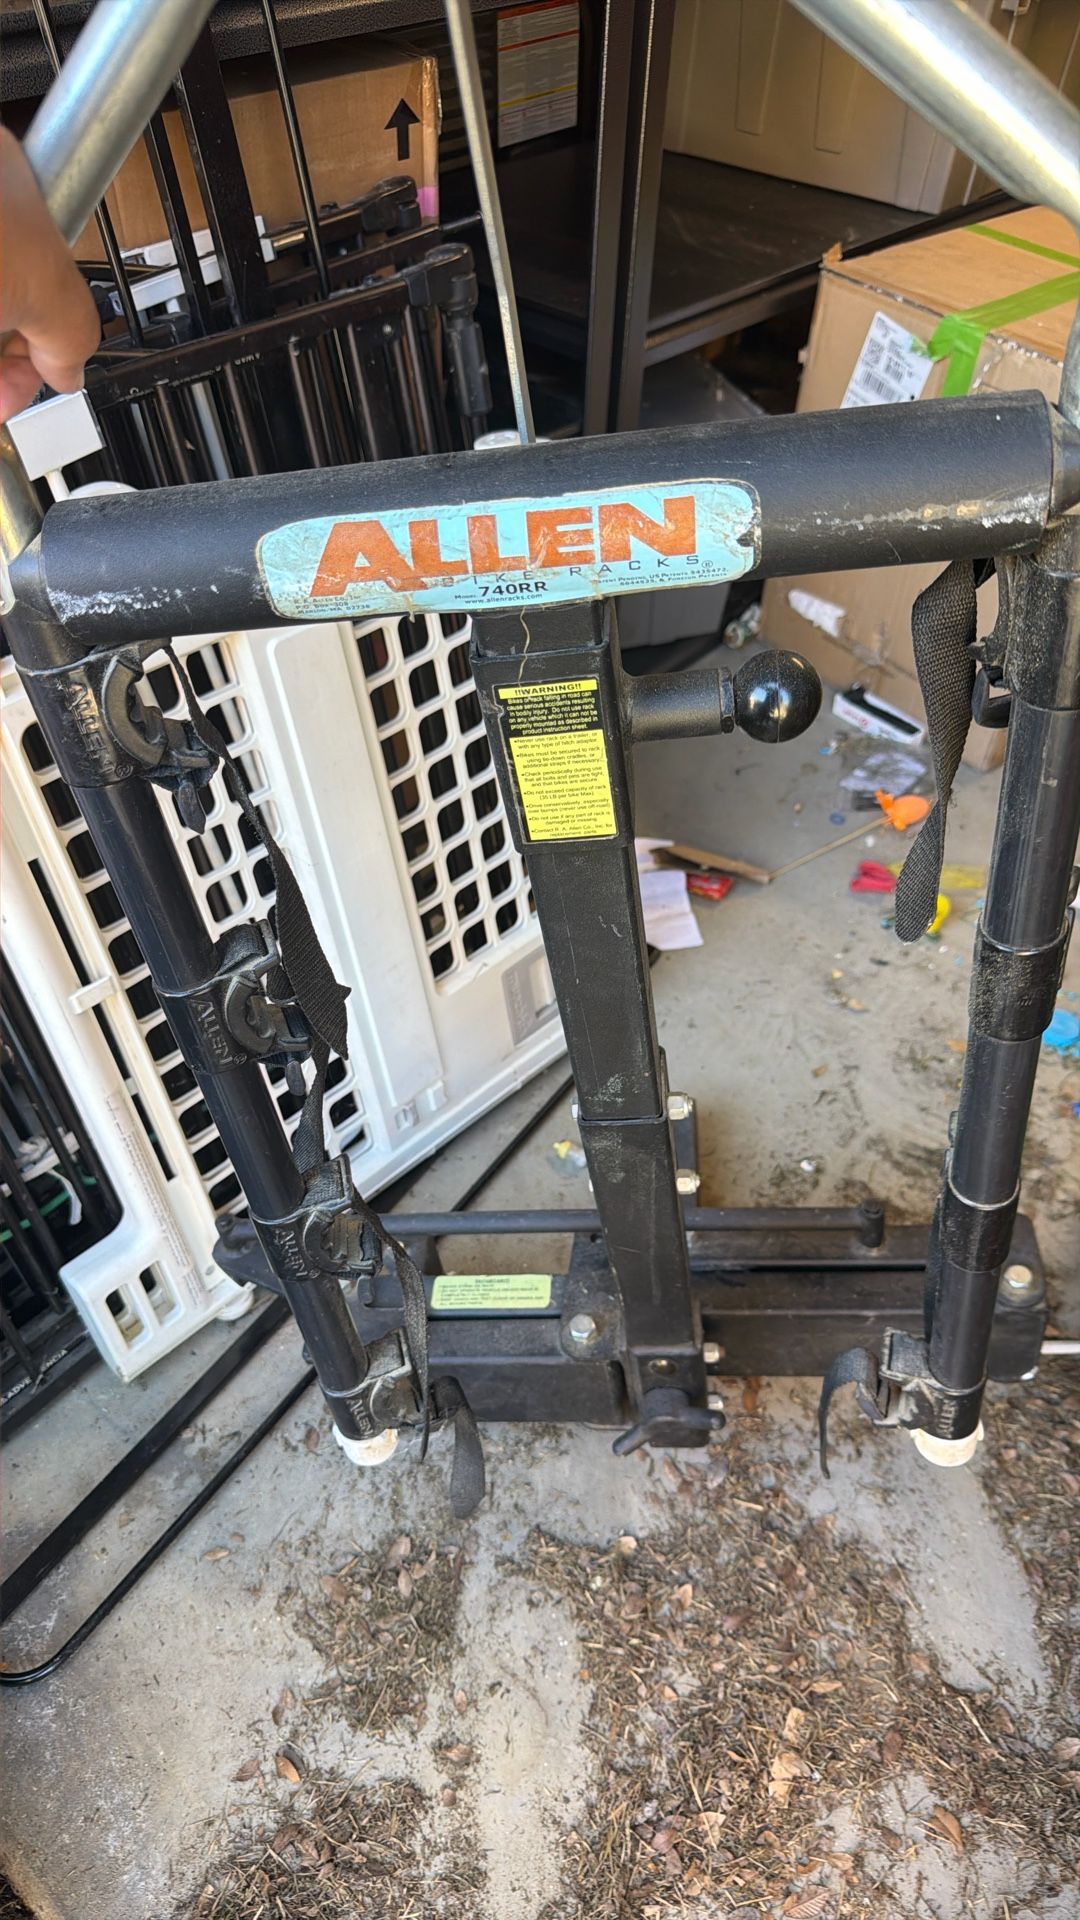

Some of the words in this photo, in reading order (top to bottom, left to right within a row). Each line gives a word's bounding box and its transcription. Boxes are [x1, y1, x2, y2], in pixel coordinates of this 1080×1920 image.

[310, 495, 696, 597] ALLEN
[478, 581, 548, 597] 740RR
[465, 593, 542, 604] www.allenracks.com
[514, 683, 581, 695] !!WARNING!!
[571, 697, 595, 705] resulting
[193, 999, 233, 1065] ALLEN
[346, 1399, 374, 1436] ALLEN
